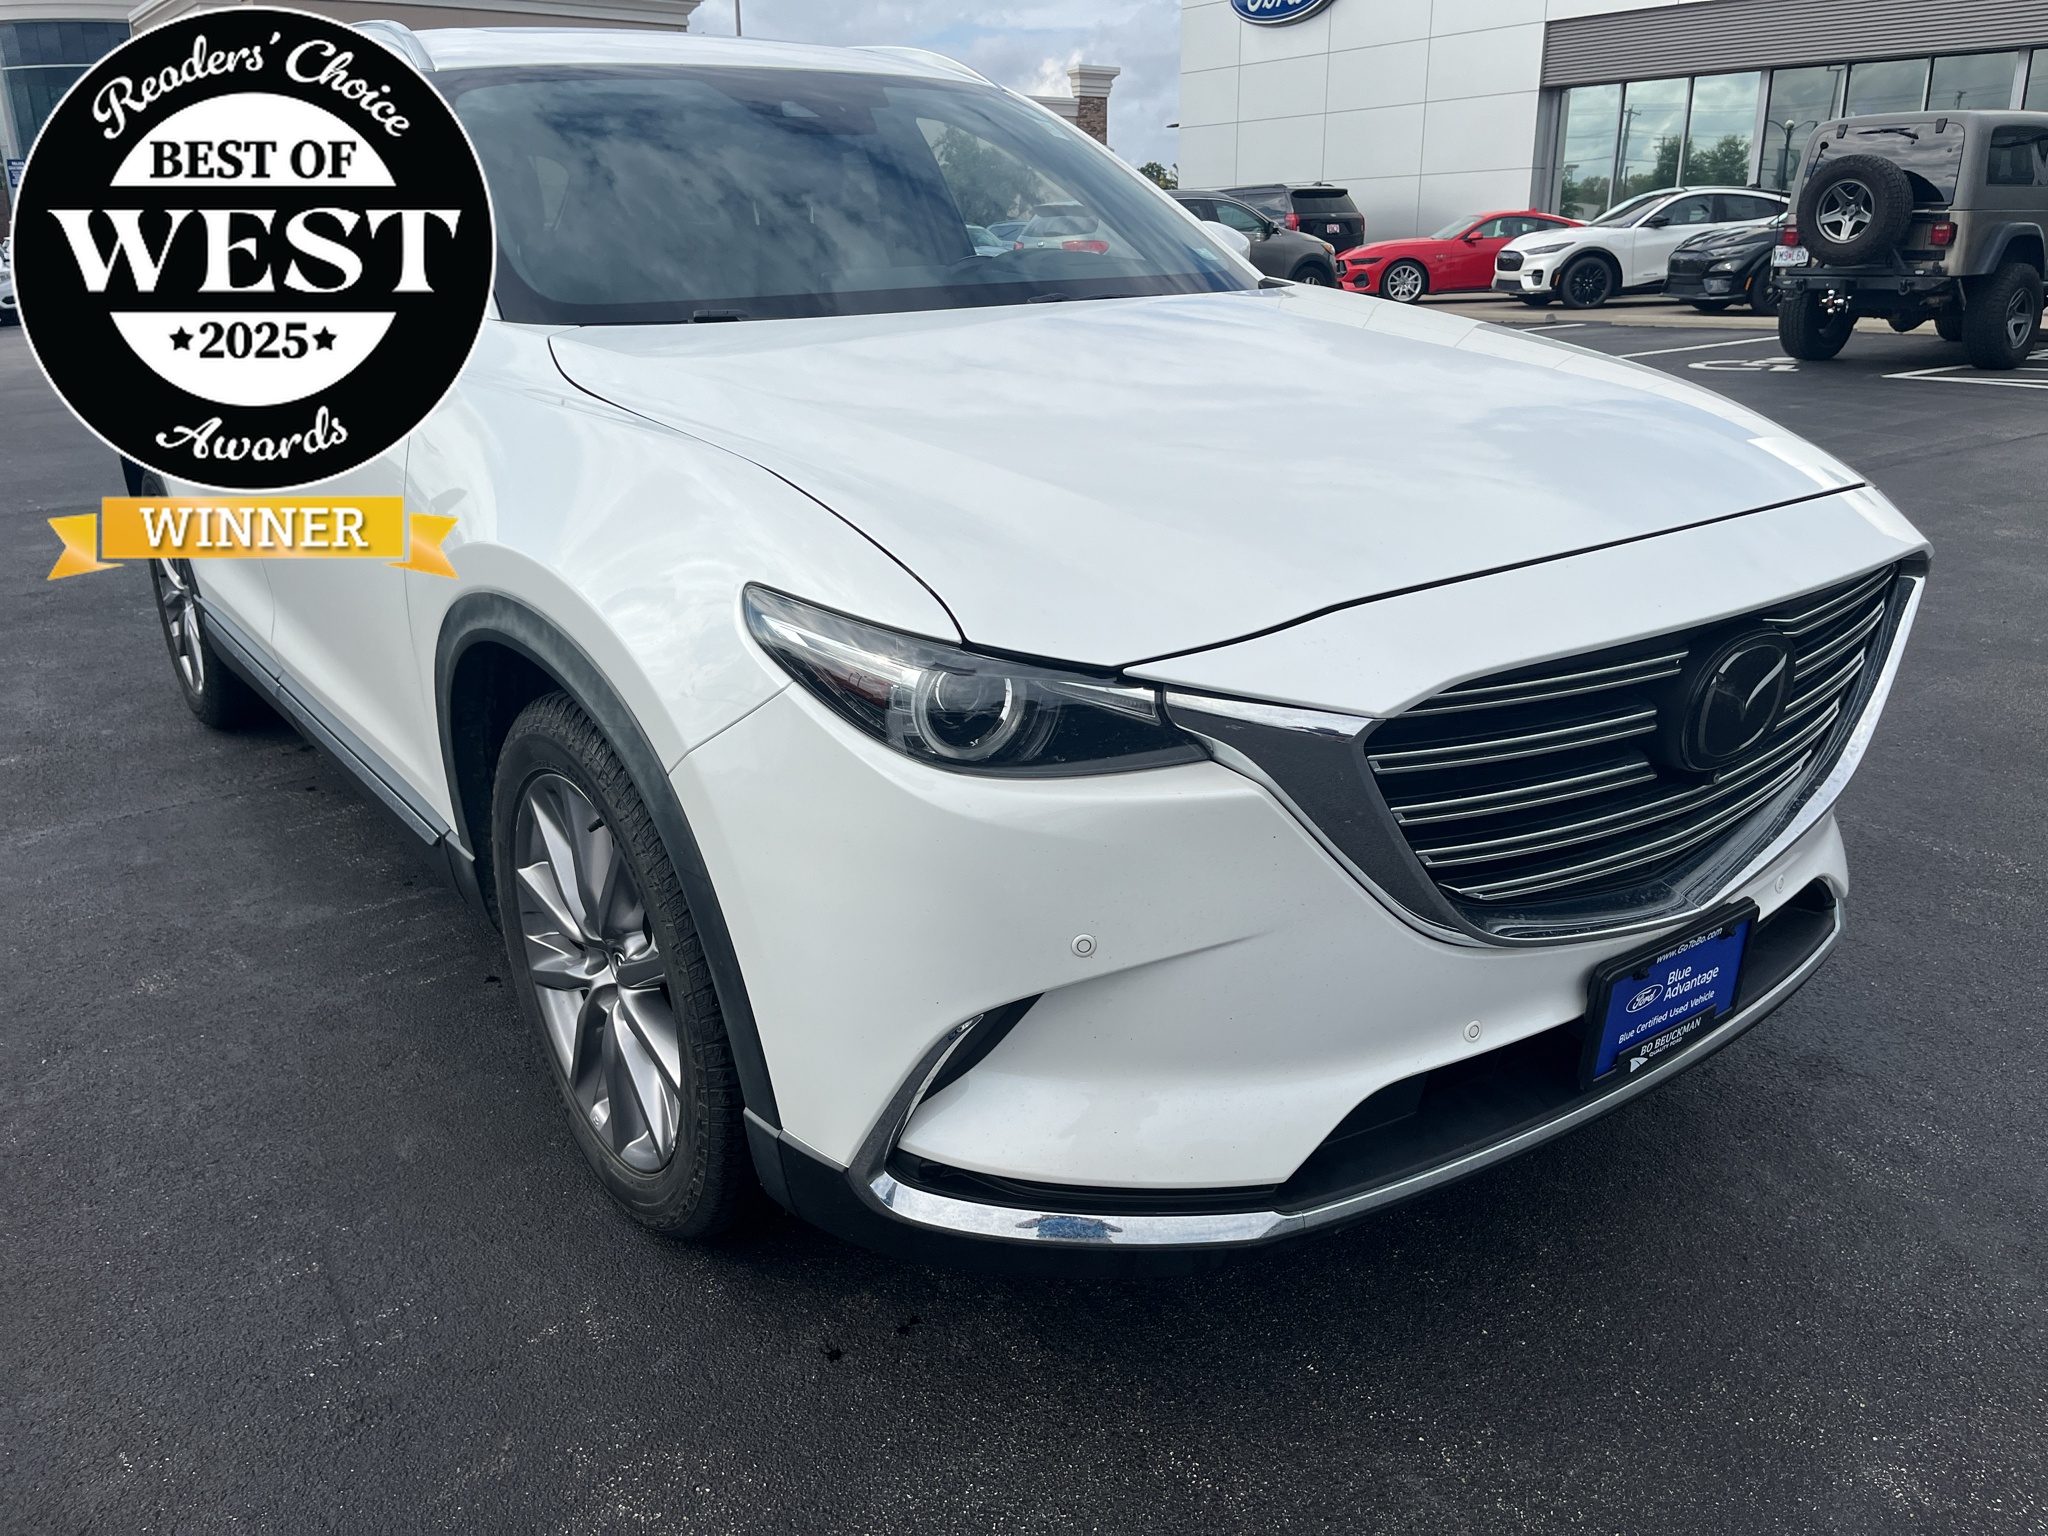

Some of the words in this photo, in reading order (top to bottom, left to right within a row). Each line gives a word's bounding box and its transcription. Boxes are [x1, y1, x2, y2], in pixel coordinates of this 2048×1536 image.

[1656, 927, 1723, 964] www.GoToBo.com
[1663, 966, 1720, 1002] Advantage
[1667, 966, 1692, 986] Blue
[1618, 1029, 1635, 1044] Blue
[1636, 1012, 1668, 1034] Certified
[1669, 1001, 1689, 1018] Used
[1690, 990, 1715, 1008] Vehicle
[1632, 988, 1657, 1010] Ford
[1640, 1042, 1653, 1056] BO
[1654, 1017, 1702, 1049] BEUCKMAN
[1649, 1043, 1670, 1057] QUALITY
[1670, 1036, 1683, 1047] FORD
